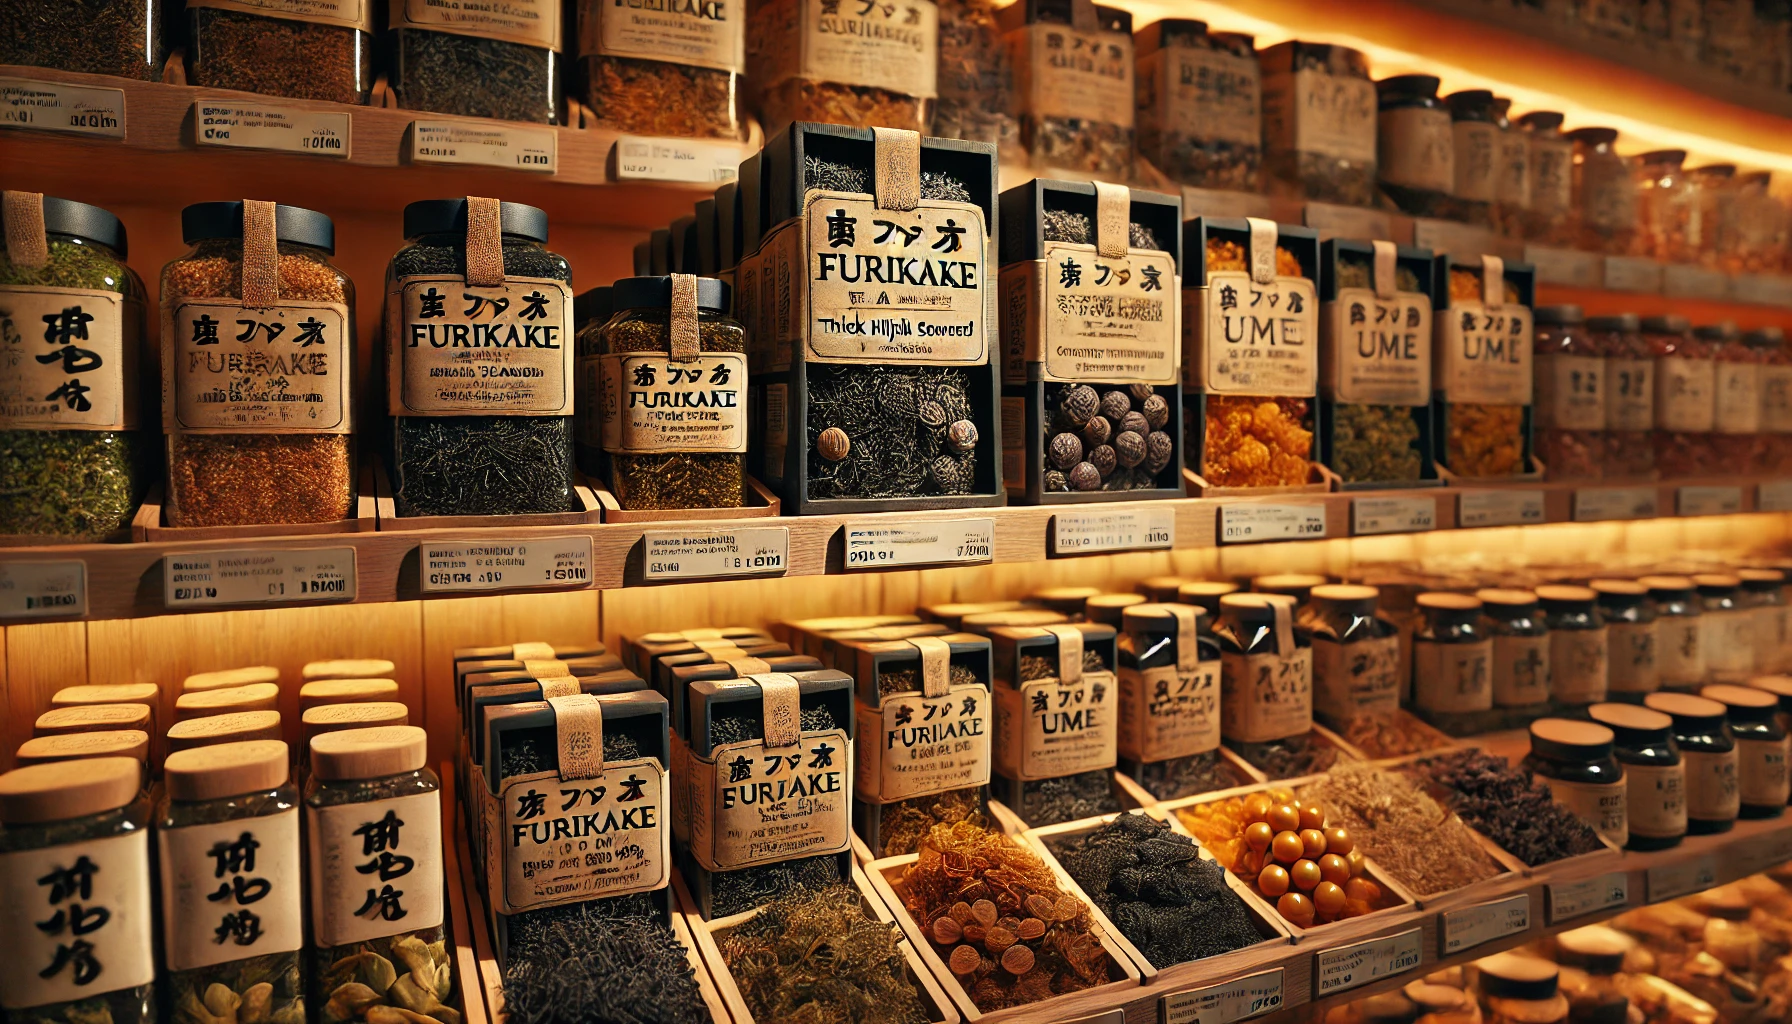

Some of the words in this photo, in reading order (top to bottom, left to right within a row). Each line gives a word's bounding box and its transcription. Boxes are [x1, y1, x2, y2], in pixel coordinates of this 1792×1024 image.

[815, 253, 978, 289] FURIKAKE
[408, 323, 560, 349] FURIKAKE
[1224, 316, 1304, 346] UME
[1358, 331, 1418, 360] UME
[1042, 708, 1102, 734] UME
[513, 805, 656, 847] FURIKAKE
